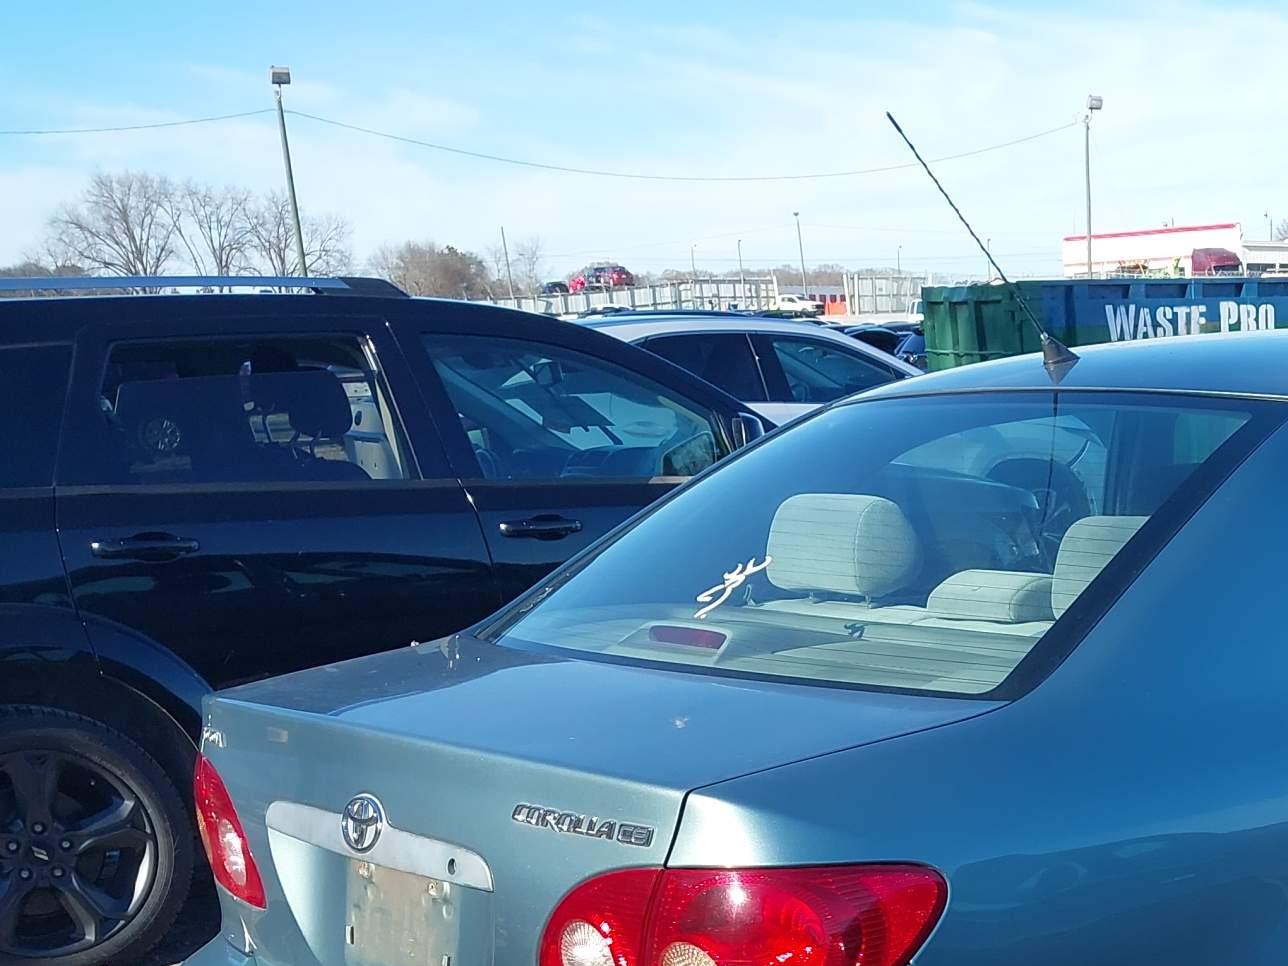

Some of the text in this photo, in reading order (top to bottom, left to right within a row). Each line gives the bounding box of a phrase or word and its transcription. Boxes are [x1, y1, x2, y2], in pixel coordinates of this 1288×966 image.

[1105, 301, 1275, 341] WASTE PRO
[512, 803, 617, 840] COROLLA
